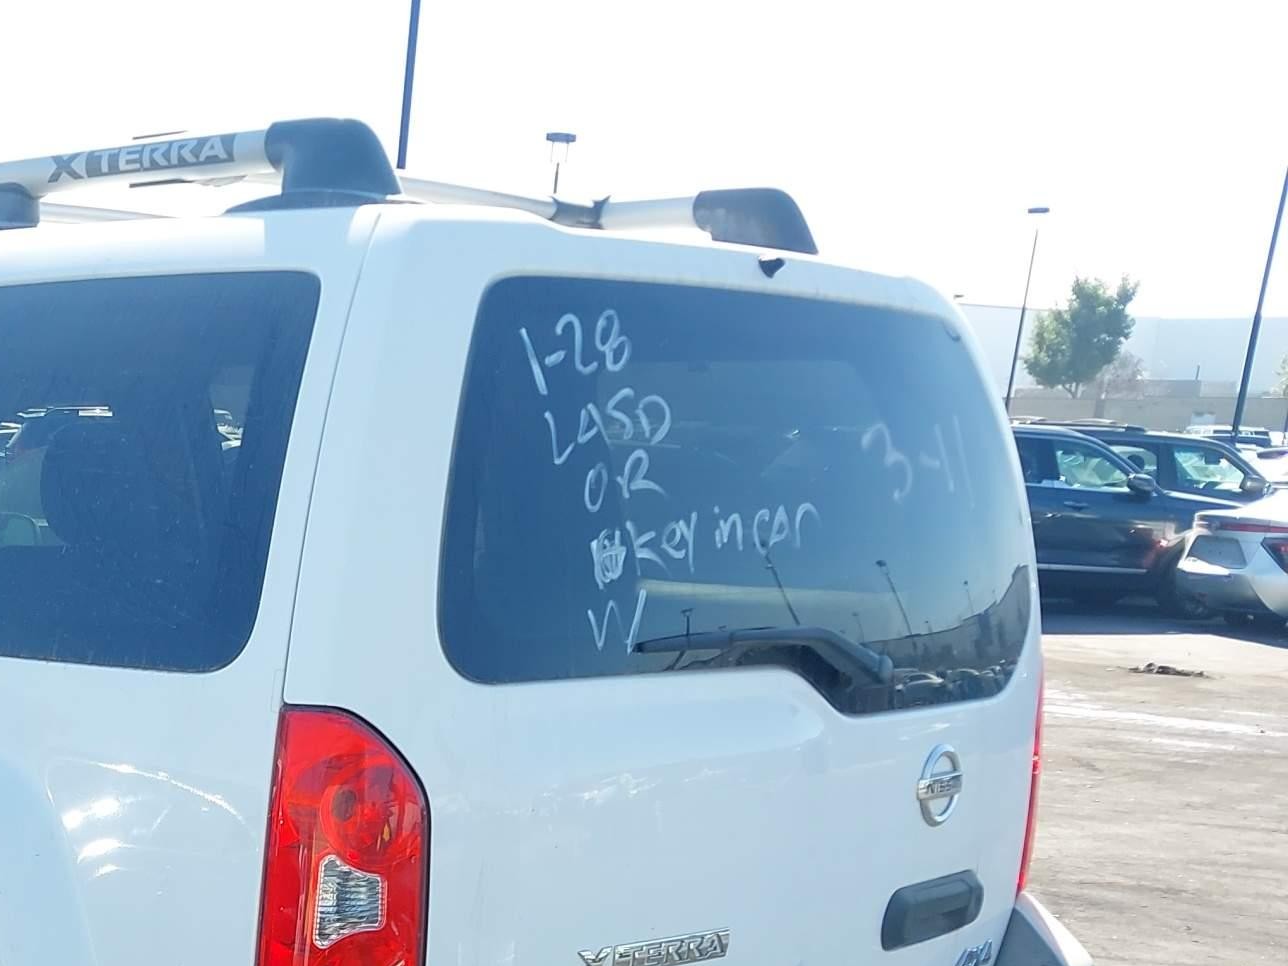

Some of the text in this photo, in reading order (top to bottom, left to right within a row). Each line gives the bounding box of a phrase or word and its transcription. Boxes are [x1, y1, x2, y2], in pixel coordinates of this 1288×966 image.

[48, 137, 230, 184] XTERRA
[519, 309, 632, 395] 1-28
[544, 387, 672, 465] LASD
[860, 415, 976, 511] 3-11
[584, 449, 667, 513] OR
